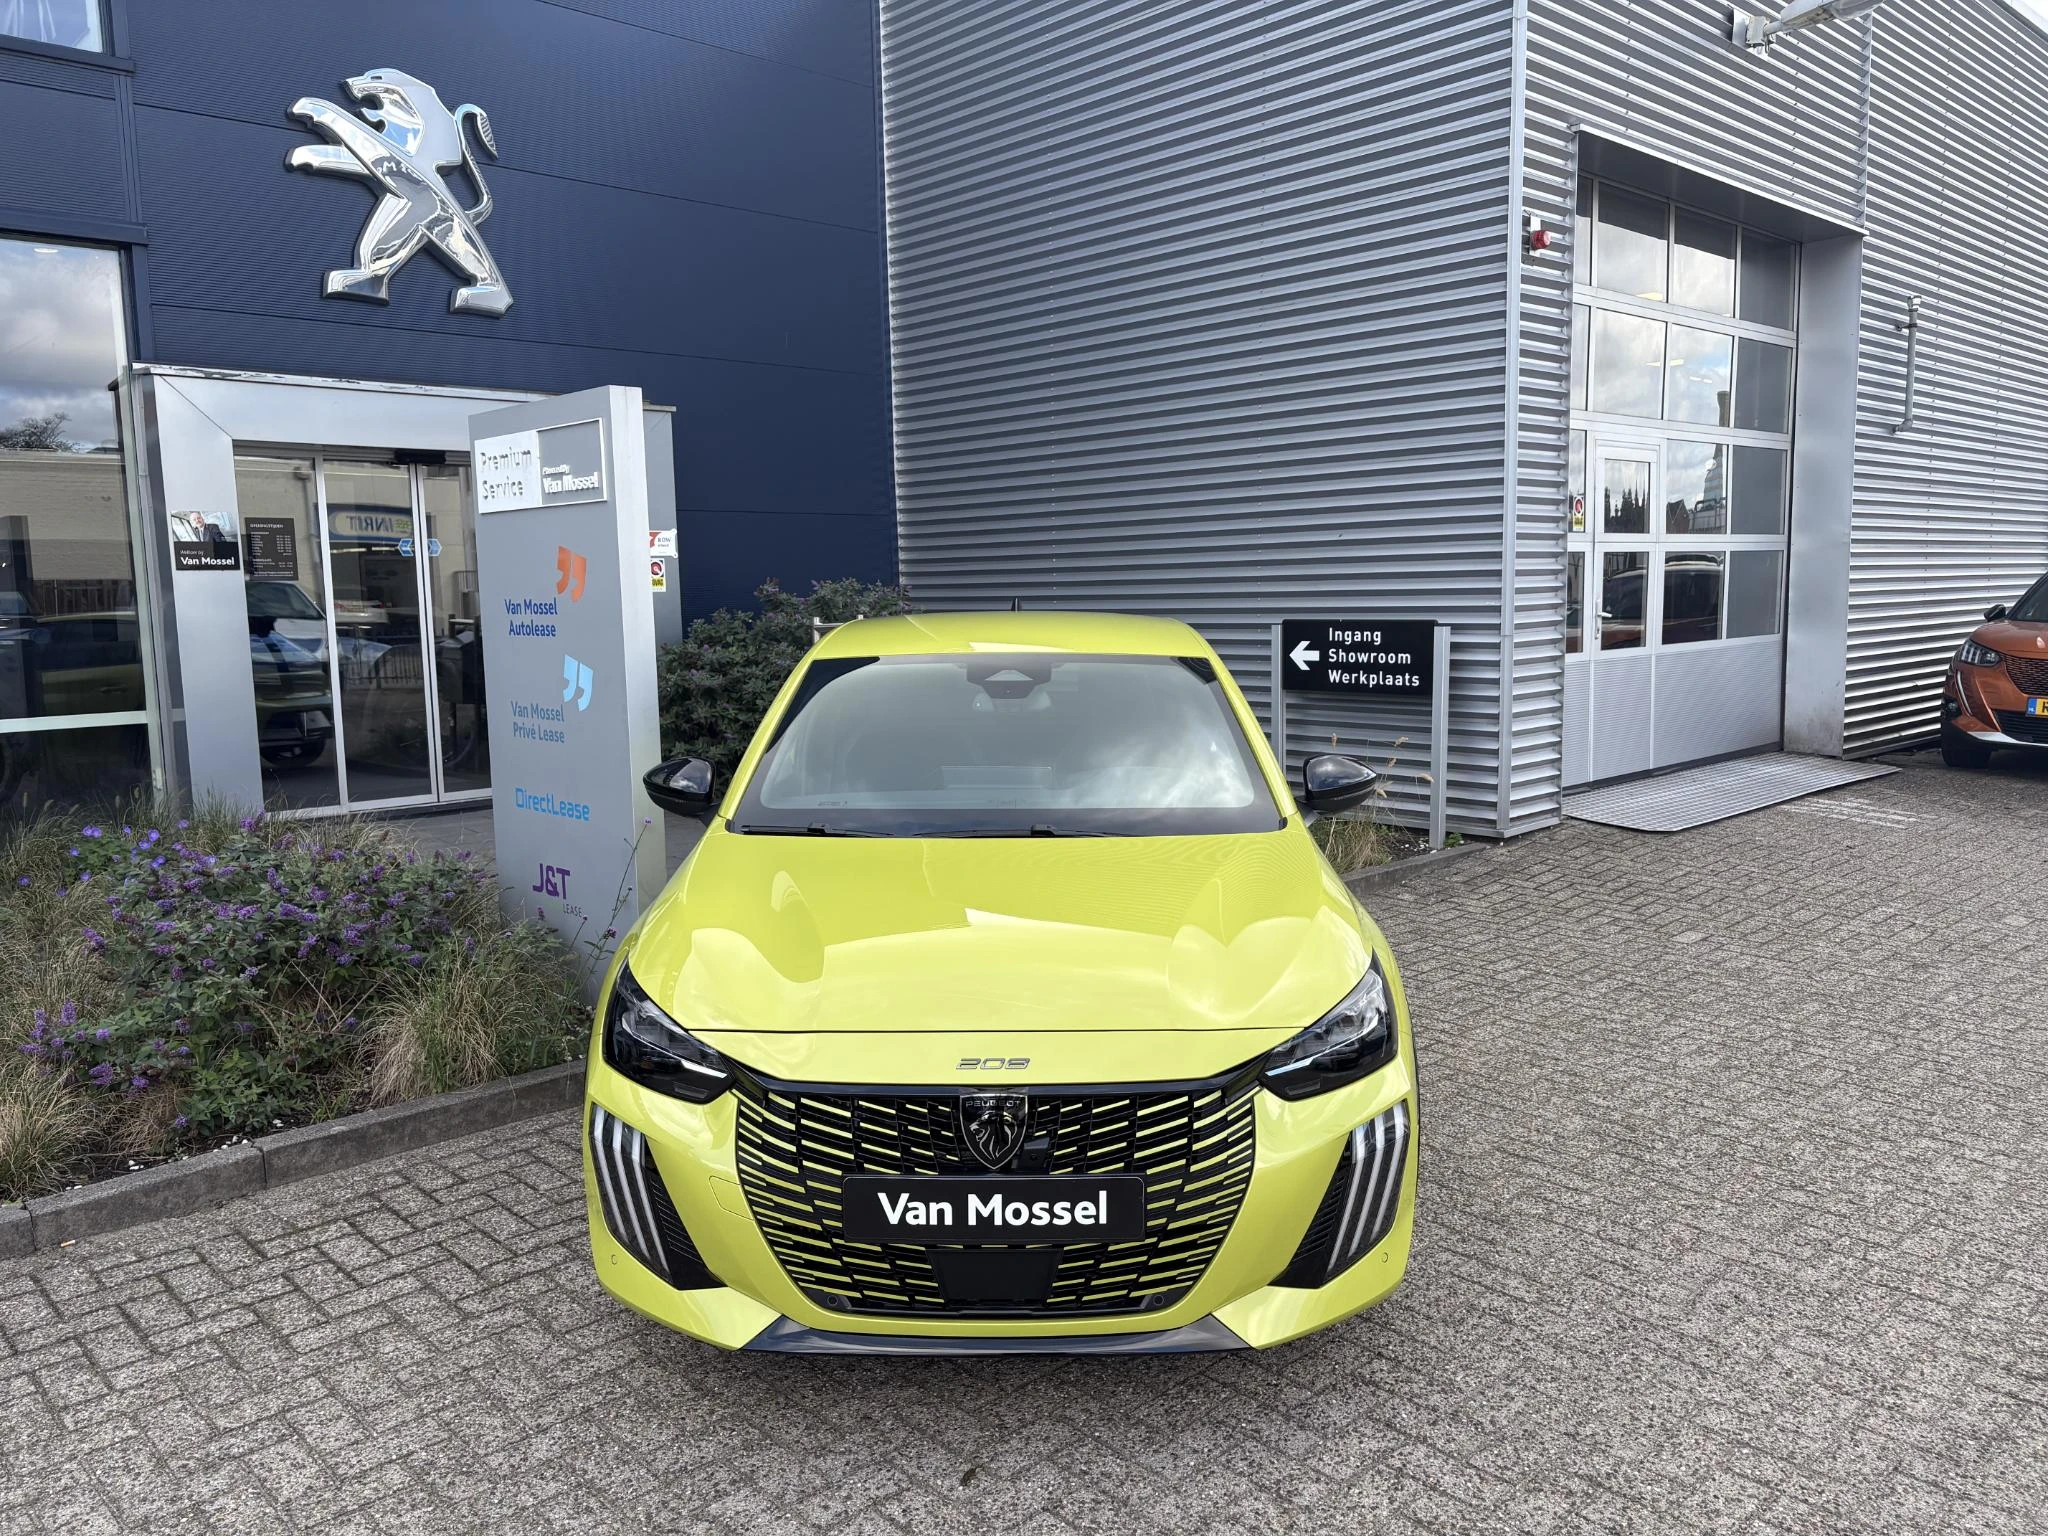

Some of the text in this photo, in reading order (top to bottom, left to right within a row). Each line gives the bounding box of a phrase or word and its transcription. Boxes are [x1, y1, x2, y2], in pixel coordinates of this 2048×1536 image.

[480, 446, 531, 471] Premium
[482, 475, 523, 500] Service
[542, 471, 599, 494] Van Mossel
[180, 556, 235, 566] Van Mossel
[504, 597, 558, 616] Van Mossel
[508, 619, 557, 637] Autolease
[1328, 627, 1382, 645] Ingang
[1328, 648, 1411, 665] Showroom
[1328, 669, 1420, 688] Werkplaats
[510, 700, 565, 723] Van Mossel
[512, 721, 566, 744] Privé Lease
[514, 787, 591, 822] DirectLease
[532, 862, 571, 901] J&T
[562, 903, 583, 918] LEASE
[956, 1057, 1031, 1070] 208
[965, 1099, 1021, 1107] PEUGEOT
[877, 1190, 1108, 1226] Van Mossel
